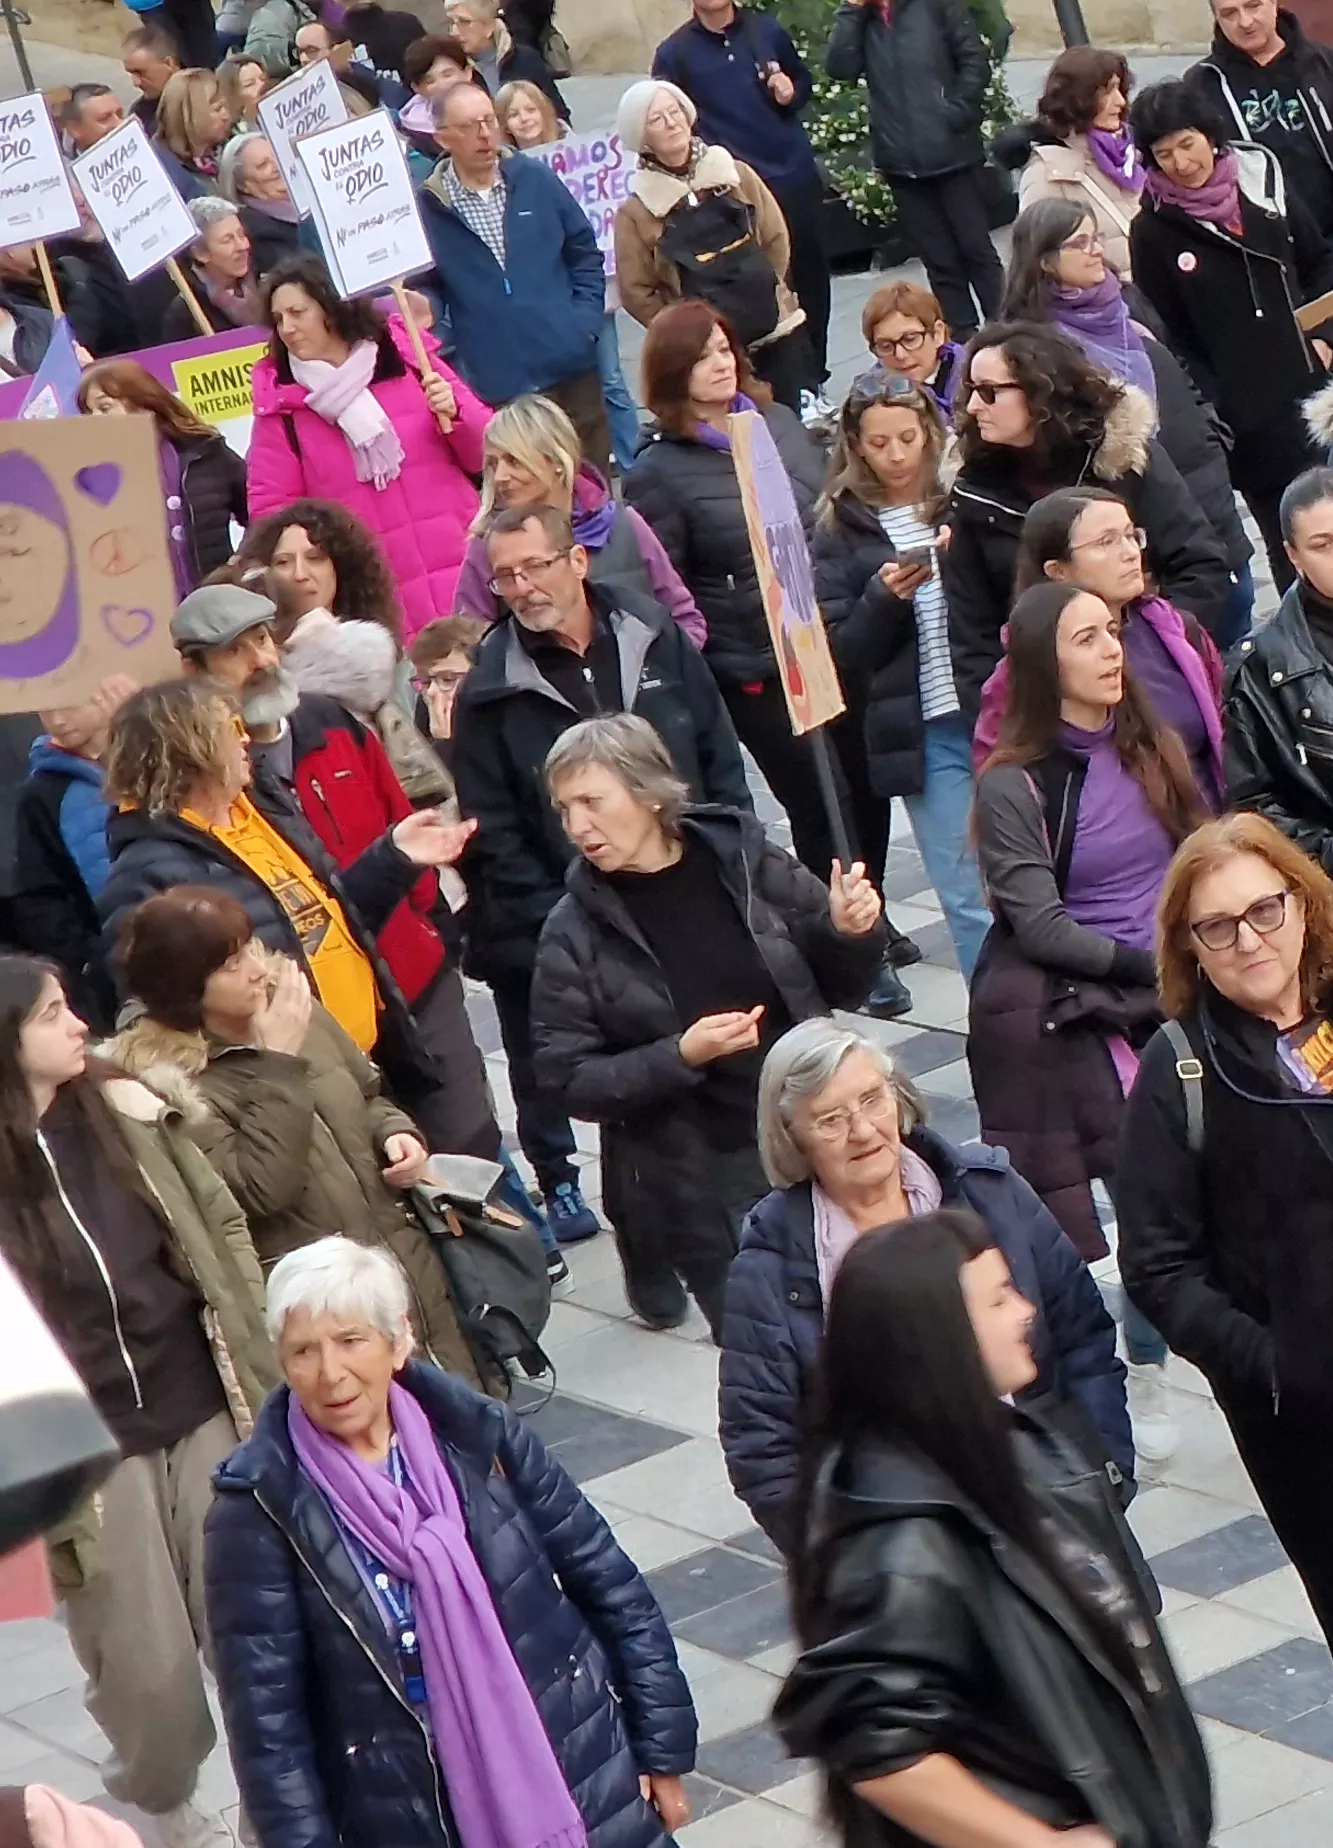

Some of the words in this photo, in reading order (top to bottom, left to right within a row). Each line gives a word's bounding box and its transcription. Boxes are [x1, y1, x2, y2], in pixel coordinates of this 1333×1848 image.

[275, 75, 326, 129] JUNTAS
[89, 137, 138, 193] JUNTAS
[318, 130, 384, 181] JUNTAS
[334, 160, 364, 178] CONTRA
[112, 165, 141, 207] ODIO
[346, 162, 384, 205] ODIO
[194, 391, 253, 416] INTERNA
